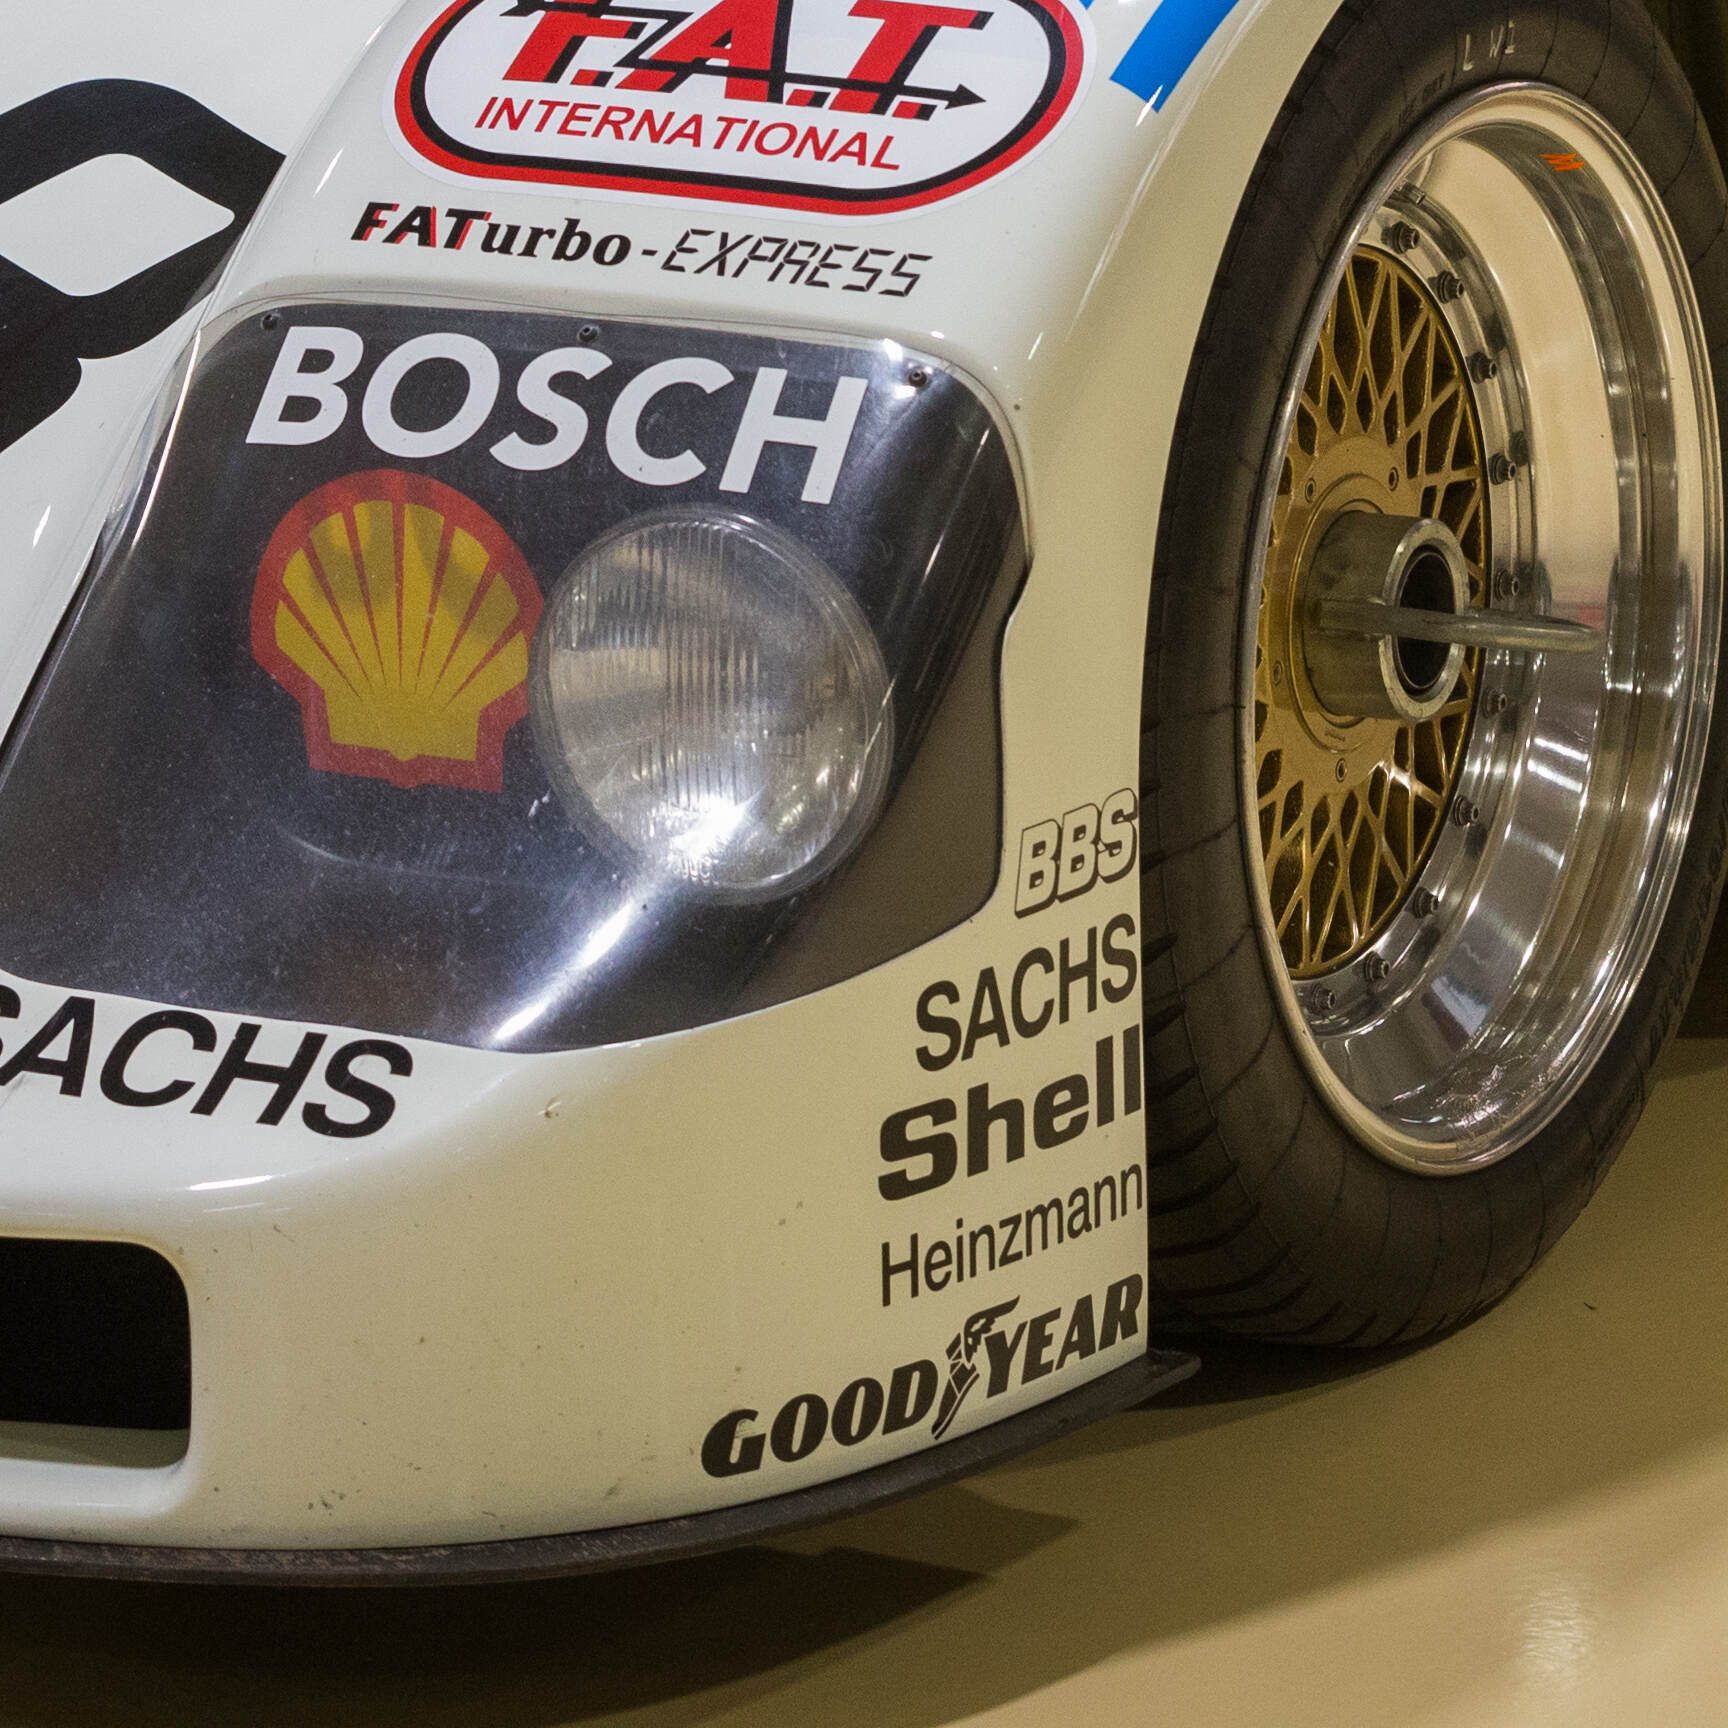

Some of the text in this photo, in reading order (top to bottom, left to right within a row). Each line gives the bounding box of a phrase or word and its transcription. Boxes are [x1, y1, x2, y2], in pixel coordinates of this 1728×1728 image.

[474, 95, 906, 173] INTERNATIONAL
[244, 324, 870, 507] BOSCH
[1013, 786, 1139, 920] BBS
[914, 912, 1139, 1072] SACHS
[876, 1023, 1143, 1202] Shell
[880, 1162, 1144, 1308] Heinzmann
